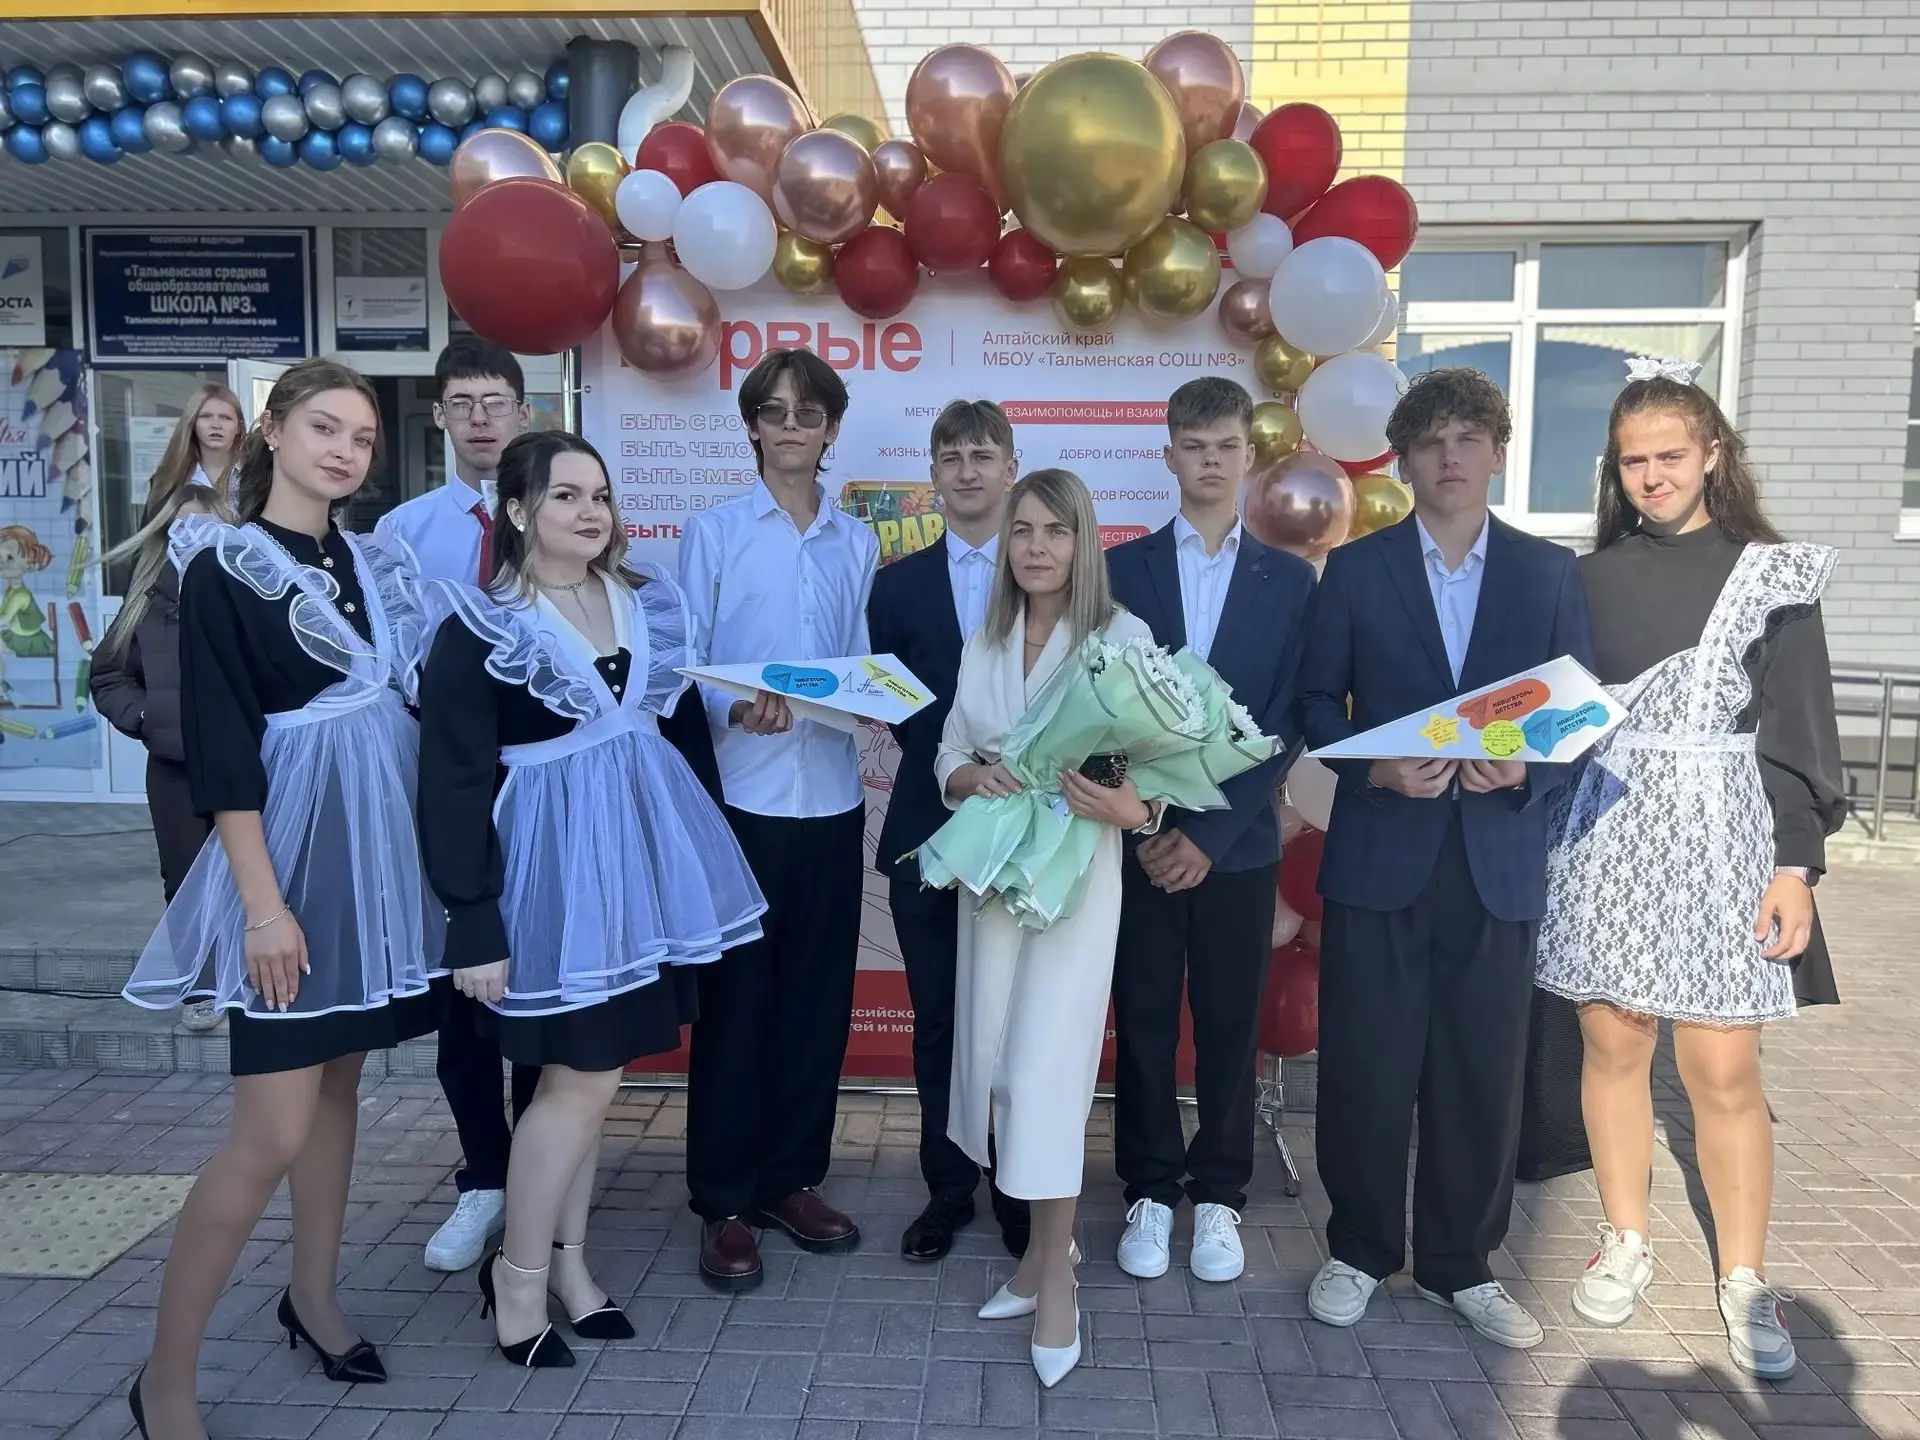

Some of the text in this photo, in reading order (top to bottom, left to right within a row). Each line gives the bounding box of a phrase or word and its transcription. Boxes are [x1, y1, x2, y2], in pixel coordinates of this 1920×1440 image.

[124, 265, 267, 280] «Тальменская средняя
[128, 279, 269, 294] общеобразовательная
[151, 295, 257, 313] ШКОЛА №3.
[983, 331, 1115, 348] Алтайский край
[720, 319, 922, 390] рвые
[983, 351, 1245, 367] МБОУ «Тальменская СОШ №3»
[1006, 407, 1168, 418] ВЗАИМОПОМОЩЬ И ВЗАИМ
[621, 414, 686, 431] БЫТЬ
[688, 414, 707, 431] С
[621, 441, 756, 459] БЫТЬ ЧЕЛО
[878, 447, 921, 457] ЖИЗНЬ
[1059, 449, 1101, 460] ДОБРО
[1104, 449, 1112, 459] И
[622, 468, 757, 485] БЫТЬ ВМЕС
[622, 494, 687, 511] БЫТЬ
[690, 495, 707, 511] В
[1119, 490, 1169, 500] РОССИИ
[625, 524, 682, 539] БЫТЬ
[1492, 689, 1534, 708] НАВИГАТОРЫ
[1495, 700, 1523, 715] ДЕТСТВА
[1556, 704, 1597, 727] НАВИГАТОРЫ
[1560, 716, 1587, 734] ДЕТСТВА
[877, 1024, 887, 1032] и
